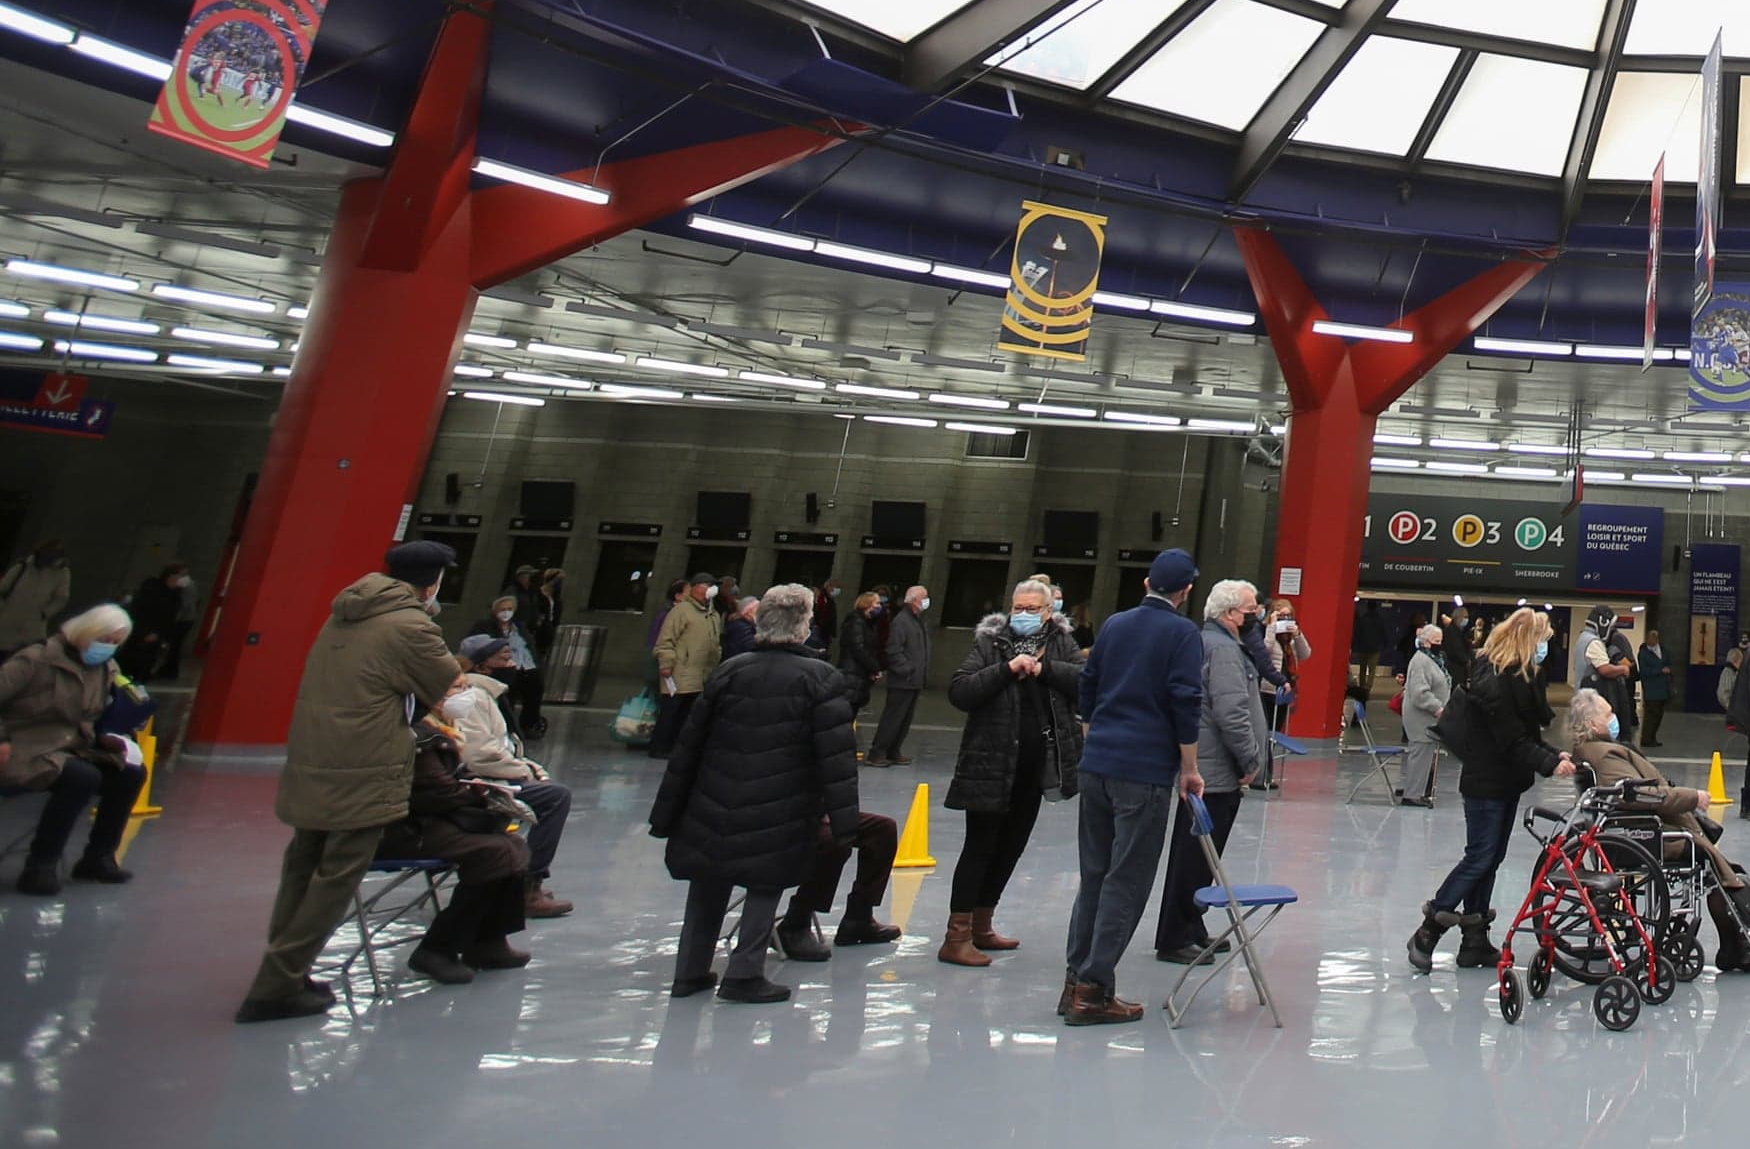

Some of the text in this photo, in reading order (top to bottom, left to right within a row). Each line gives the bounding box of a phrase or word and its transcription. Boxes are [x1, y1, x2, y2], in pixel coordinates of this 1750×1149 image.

[1587, 523, 1649, 534] REGROUPEMENT
[1586, 533, 1648, 543] LOISIR ET SPORT
[1599, 542, 1630, 551] QUÉBEC
[1395, 563, 1434, 572] COUBERTIN
[1515, 570, 1560, 579] SHERBROOKE
